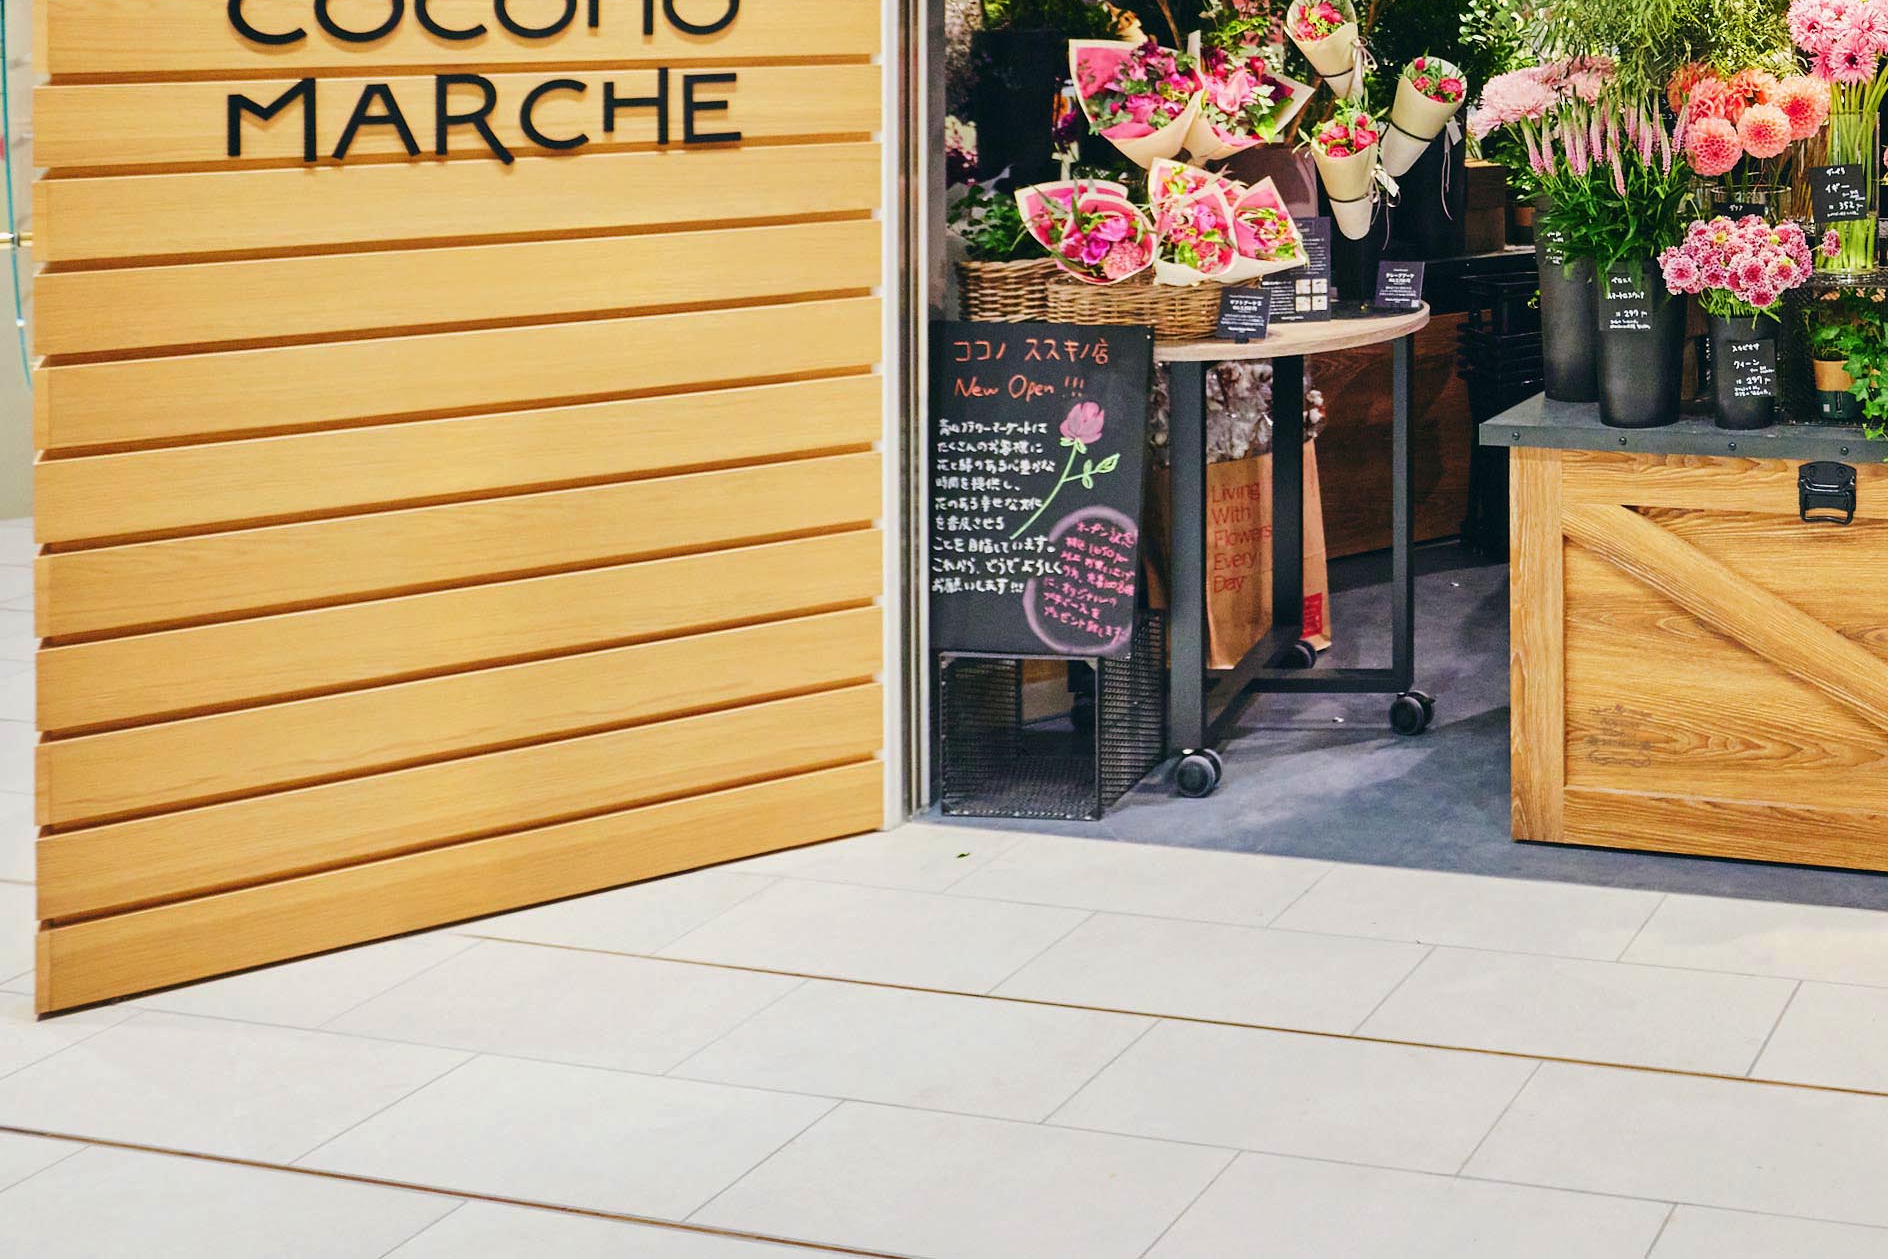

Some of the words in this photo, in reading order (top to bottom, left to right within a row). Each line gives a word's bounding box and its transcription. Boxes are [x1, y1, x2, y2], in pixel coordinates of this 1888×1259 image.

[226, 66, 742, 165] MARCHE
[953, 340, 1006, 362] ココノ
[1024, 338, 1109, 365] ススキノ店
[954, 375, 999, 398] New
[1008, 373, 1055, 402] Open
[1212, 482, 1260, 503] Living
[1212, 506, 1250, 525] With
[1214, 524, 1273, 550] Flowers
[1214, 550, 1261, 571] Every
[1214, 575, 1247, 594] Day
